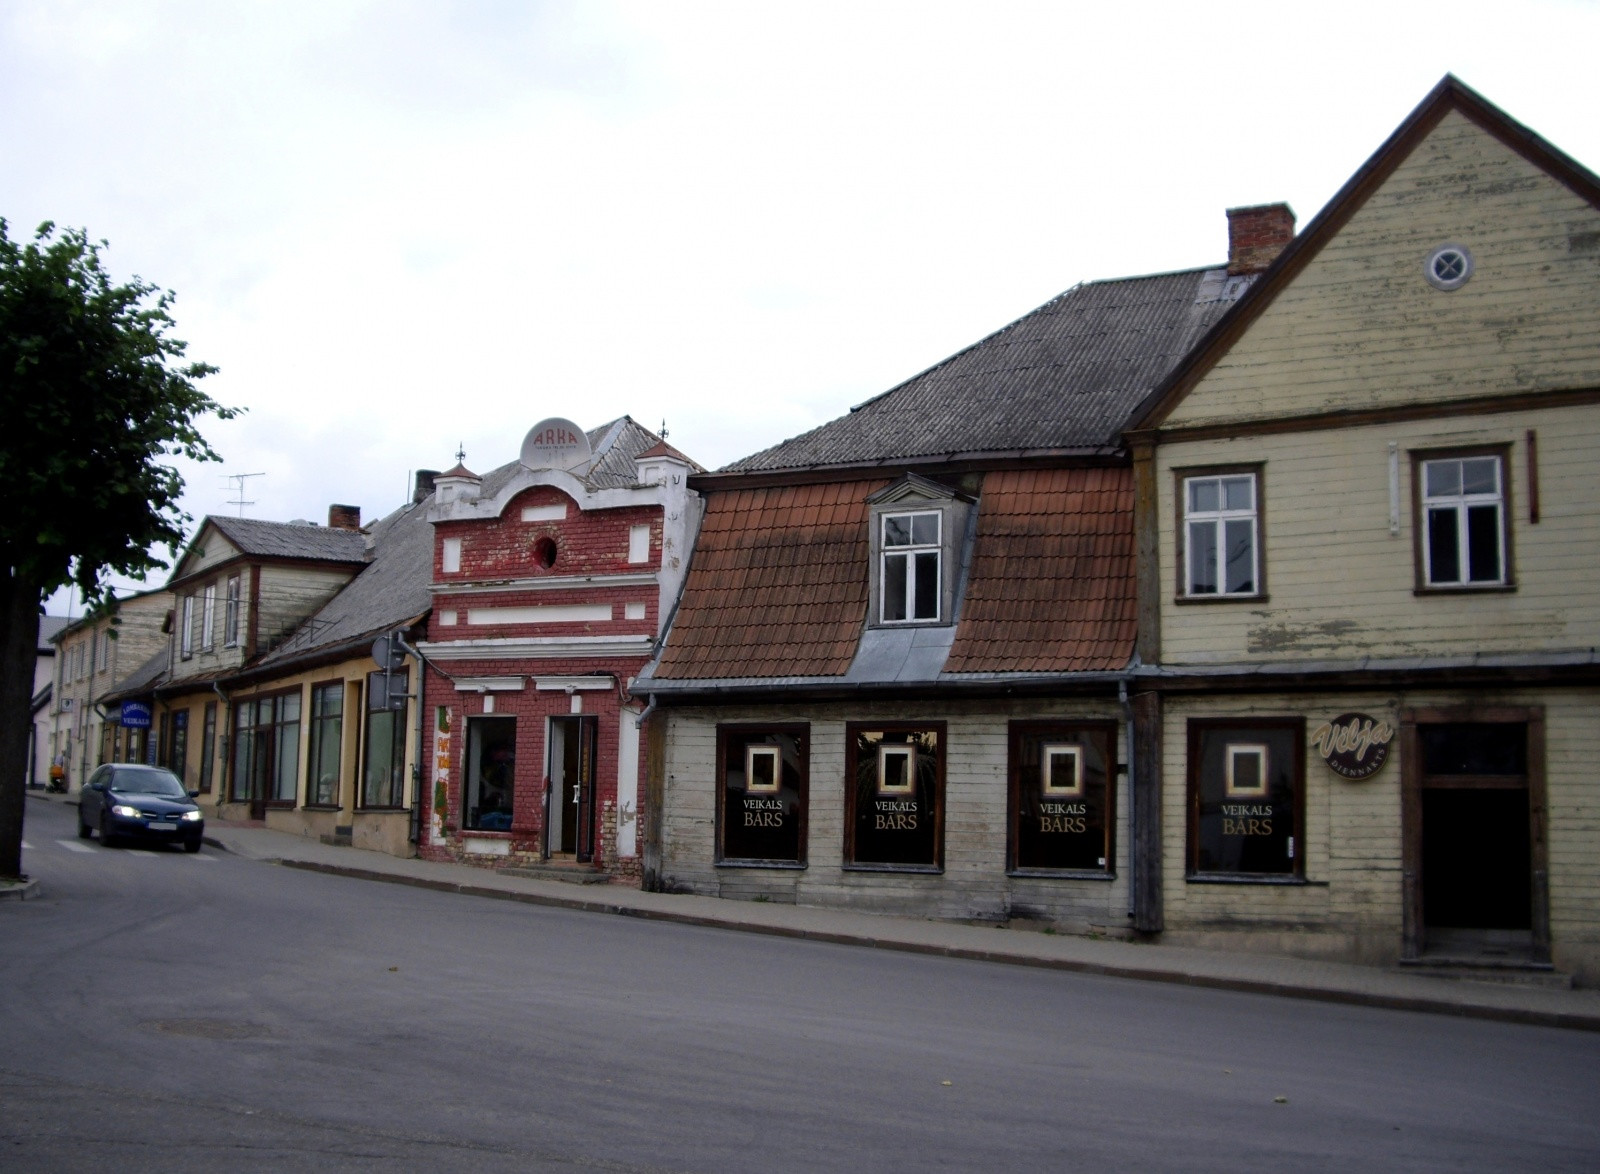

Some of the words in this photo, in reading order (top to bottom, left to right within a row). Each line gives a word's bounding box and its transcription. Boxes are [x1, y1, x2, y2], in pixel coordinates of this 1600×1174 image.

[533, 428, 578, 445] ARKA
[1311, 717, 1394, 761] Vilja
[1331, 748, 1385, 776] DIENNAKTS
[744, 799, 783, 810] VEIKALS
[875, 801, 918, 812] VEIKALS
[1040, 803, 1086, 815] VEIKALS
[1222, 805, 1273, 816] VEIKALS
[744, 810, 783, 827] BĀRS
[875, 812, 918, 830] BĀRS
[1040, 815, 1086, 833] BĀRS
[1222, 816, 1273, 836] BĀRS
